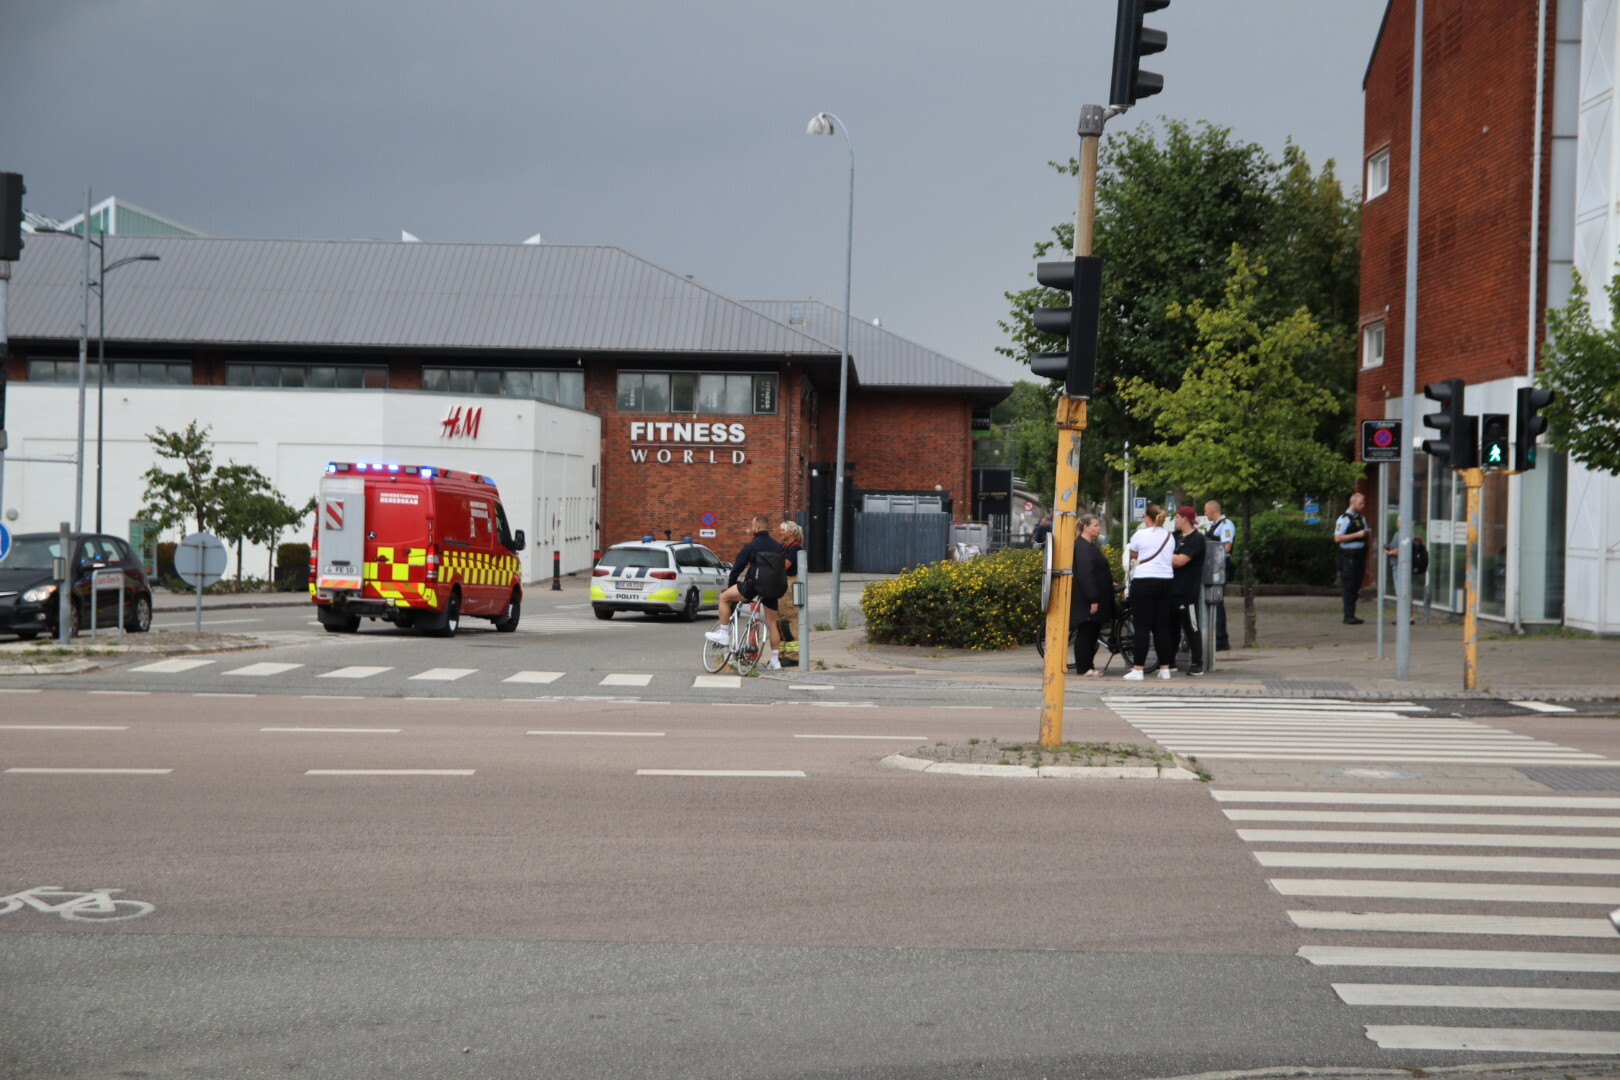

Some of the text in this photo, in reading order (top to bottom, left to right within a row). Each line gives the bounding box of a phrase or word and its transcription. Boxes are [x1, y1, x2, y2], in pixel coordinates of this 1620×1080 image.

[441, 405, 483, 439] H&M
[631, 421, 745, 443] FITNESS
[631, 449, 745, 464] WORLD
